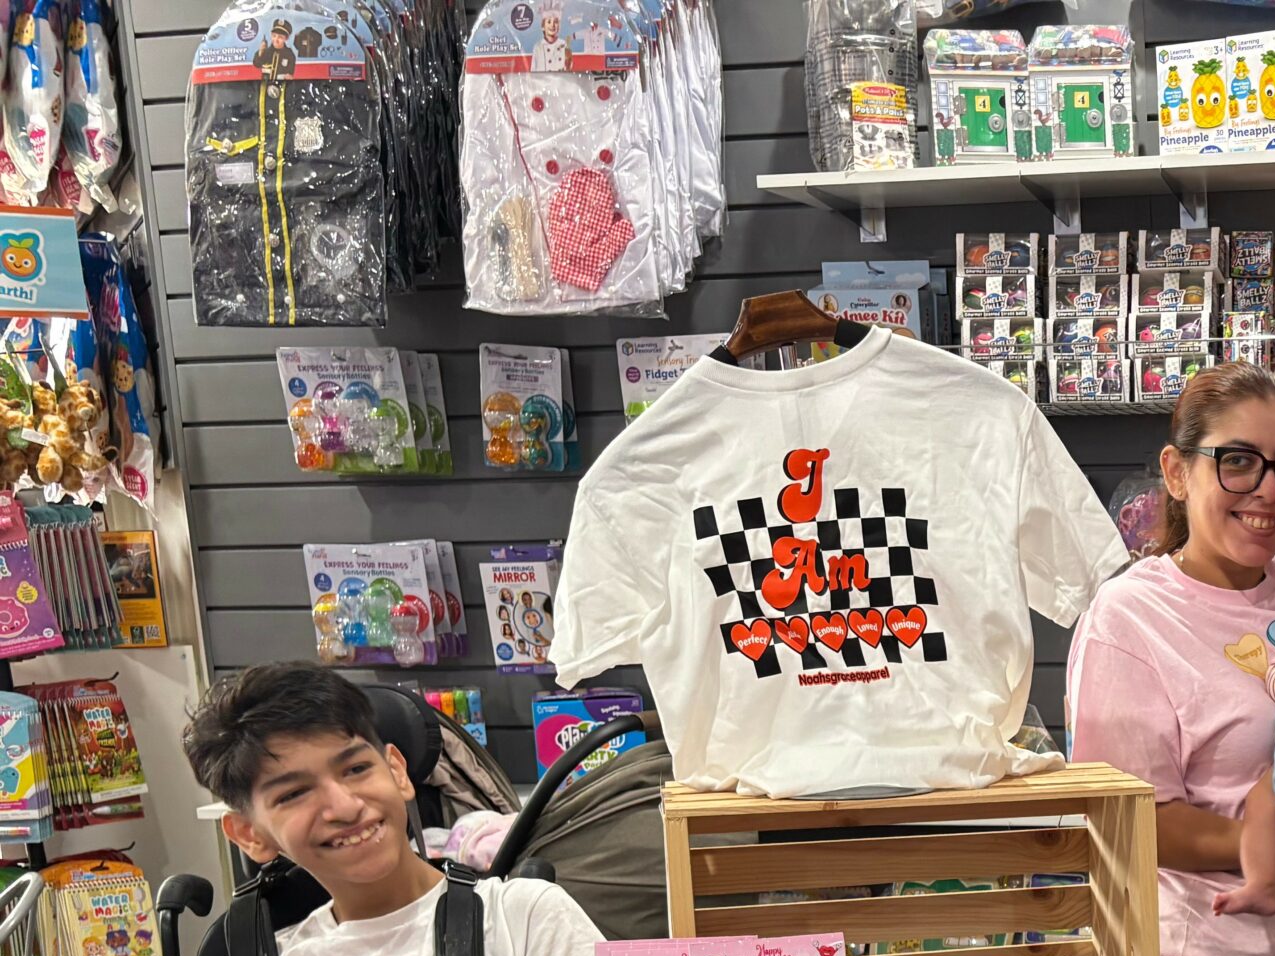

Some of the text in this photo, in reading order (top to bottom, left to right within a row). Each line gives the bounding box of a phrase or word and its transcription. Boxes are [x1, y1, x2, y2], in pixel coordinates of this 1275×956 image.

[1238, 38, 1259, 46] Learning
[1170, 46, 1223, 56] Learning 3+
[855, 105, 874, 114] Pots
[1160, 133, 1209, 146] Pineapple
[1076, 251, 1100, 261] SMELLY
[1166, 246, 1191, 256] SMELLY
[985, 252, 1010, 262] SMELLY
[1237, 286, 1270, 299] SMELLY
[982, 295, 1007, 305] SMELLY
[1075, 295, 1100, 304] SMELLY
[1239, 297, 1268, 307] BALLZ
[882, 310, 906, 325] Kit
[297, 364, 328, 373] EXPRESS
[645, 369, 678, 381] Fidget
[777, 448, 830, 523] I
[324, 560, 409, 570] EXPRESS YOUR FEELINGS
[343, 568, 395, 577] Sensory Bottles
[493, 572, 536, 583] MIRROR
[761, 536, 871, 610] Am
[857, 622, 878, 633] Loved
[891, 619, 921, 632] Unique
[816, 626, 844, 639] Enough
[737, 636, 768, 650] Perfect
[798, 666, 890, 687] Noahsgraceapparel
[84, 707, 111, 720] WATER
[91, 894, 129, 907] WATER
[94, 904, 129, 917] MAGIC
